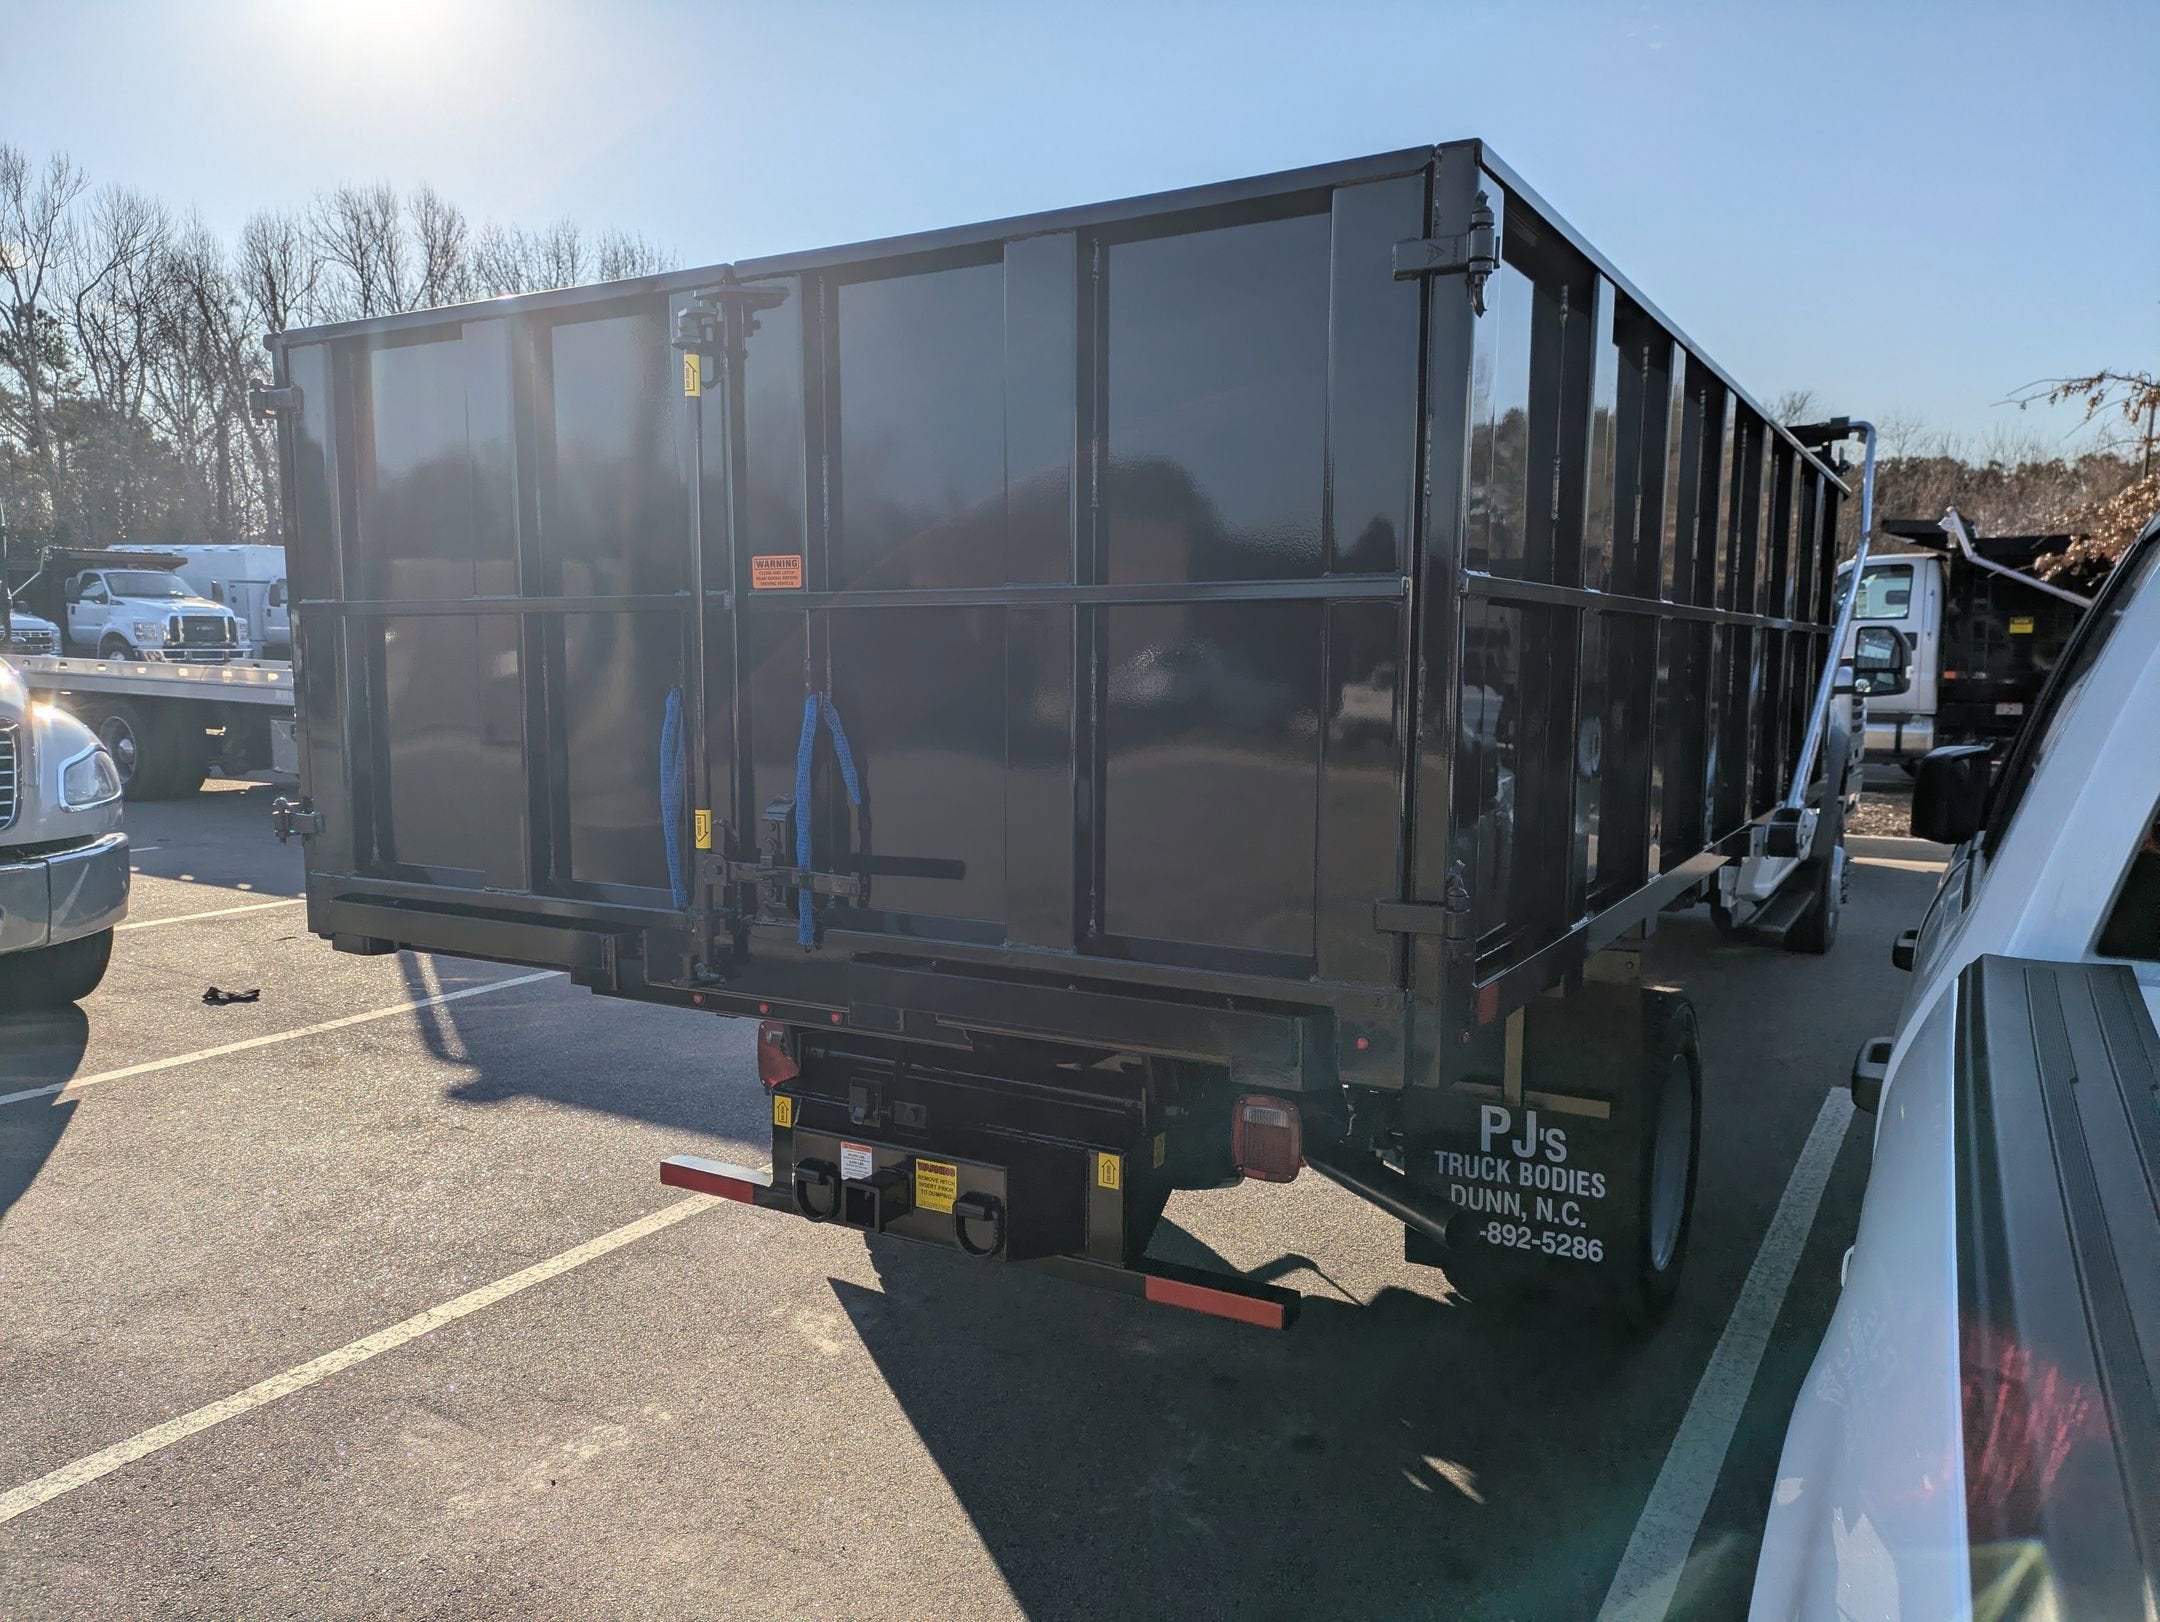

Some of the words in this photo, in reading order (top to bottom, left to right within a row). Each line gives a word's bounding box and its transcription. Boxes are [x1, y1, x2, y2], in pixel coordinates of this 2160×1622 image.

[755, 559, 798, 568] WARNING
[917, 1174, 939, 1184] REMOVE
[1434, 1150, 1511, 1184] TRUCK
[1519, 1161, 1606, 1199] BODIES
[1450, 1183, 1527, 1222] DUNN,
[1536, 1196, 1587, 1229] N.C.
